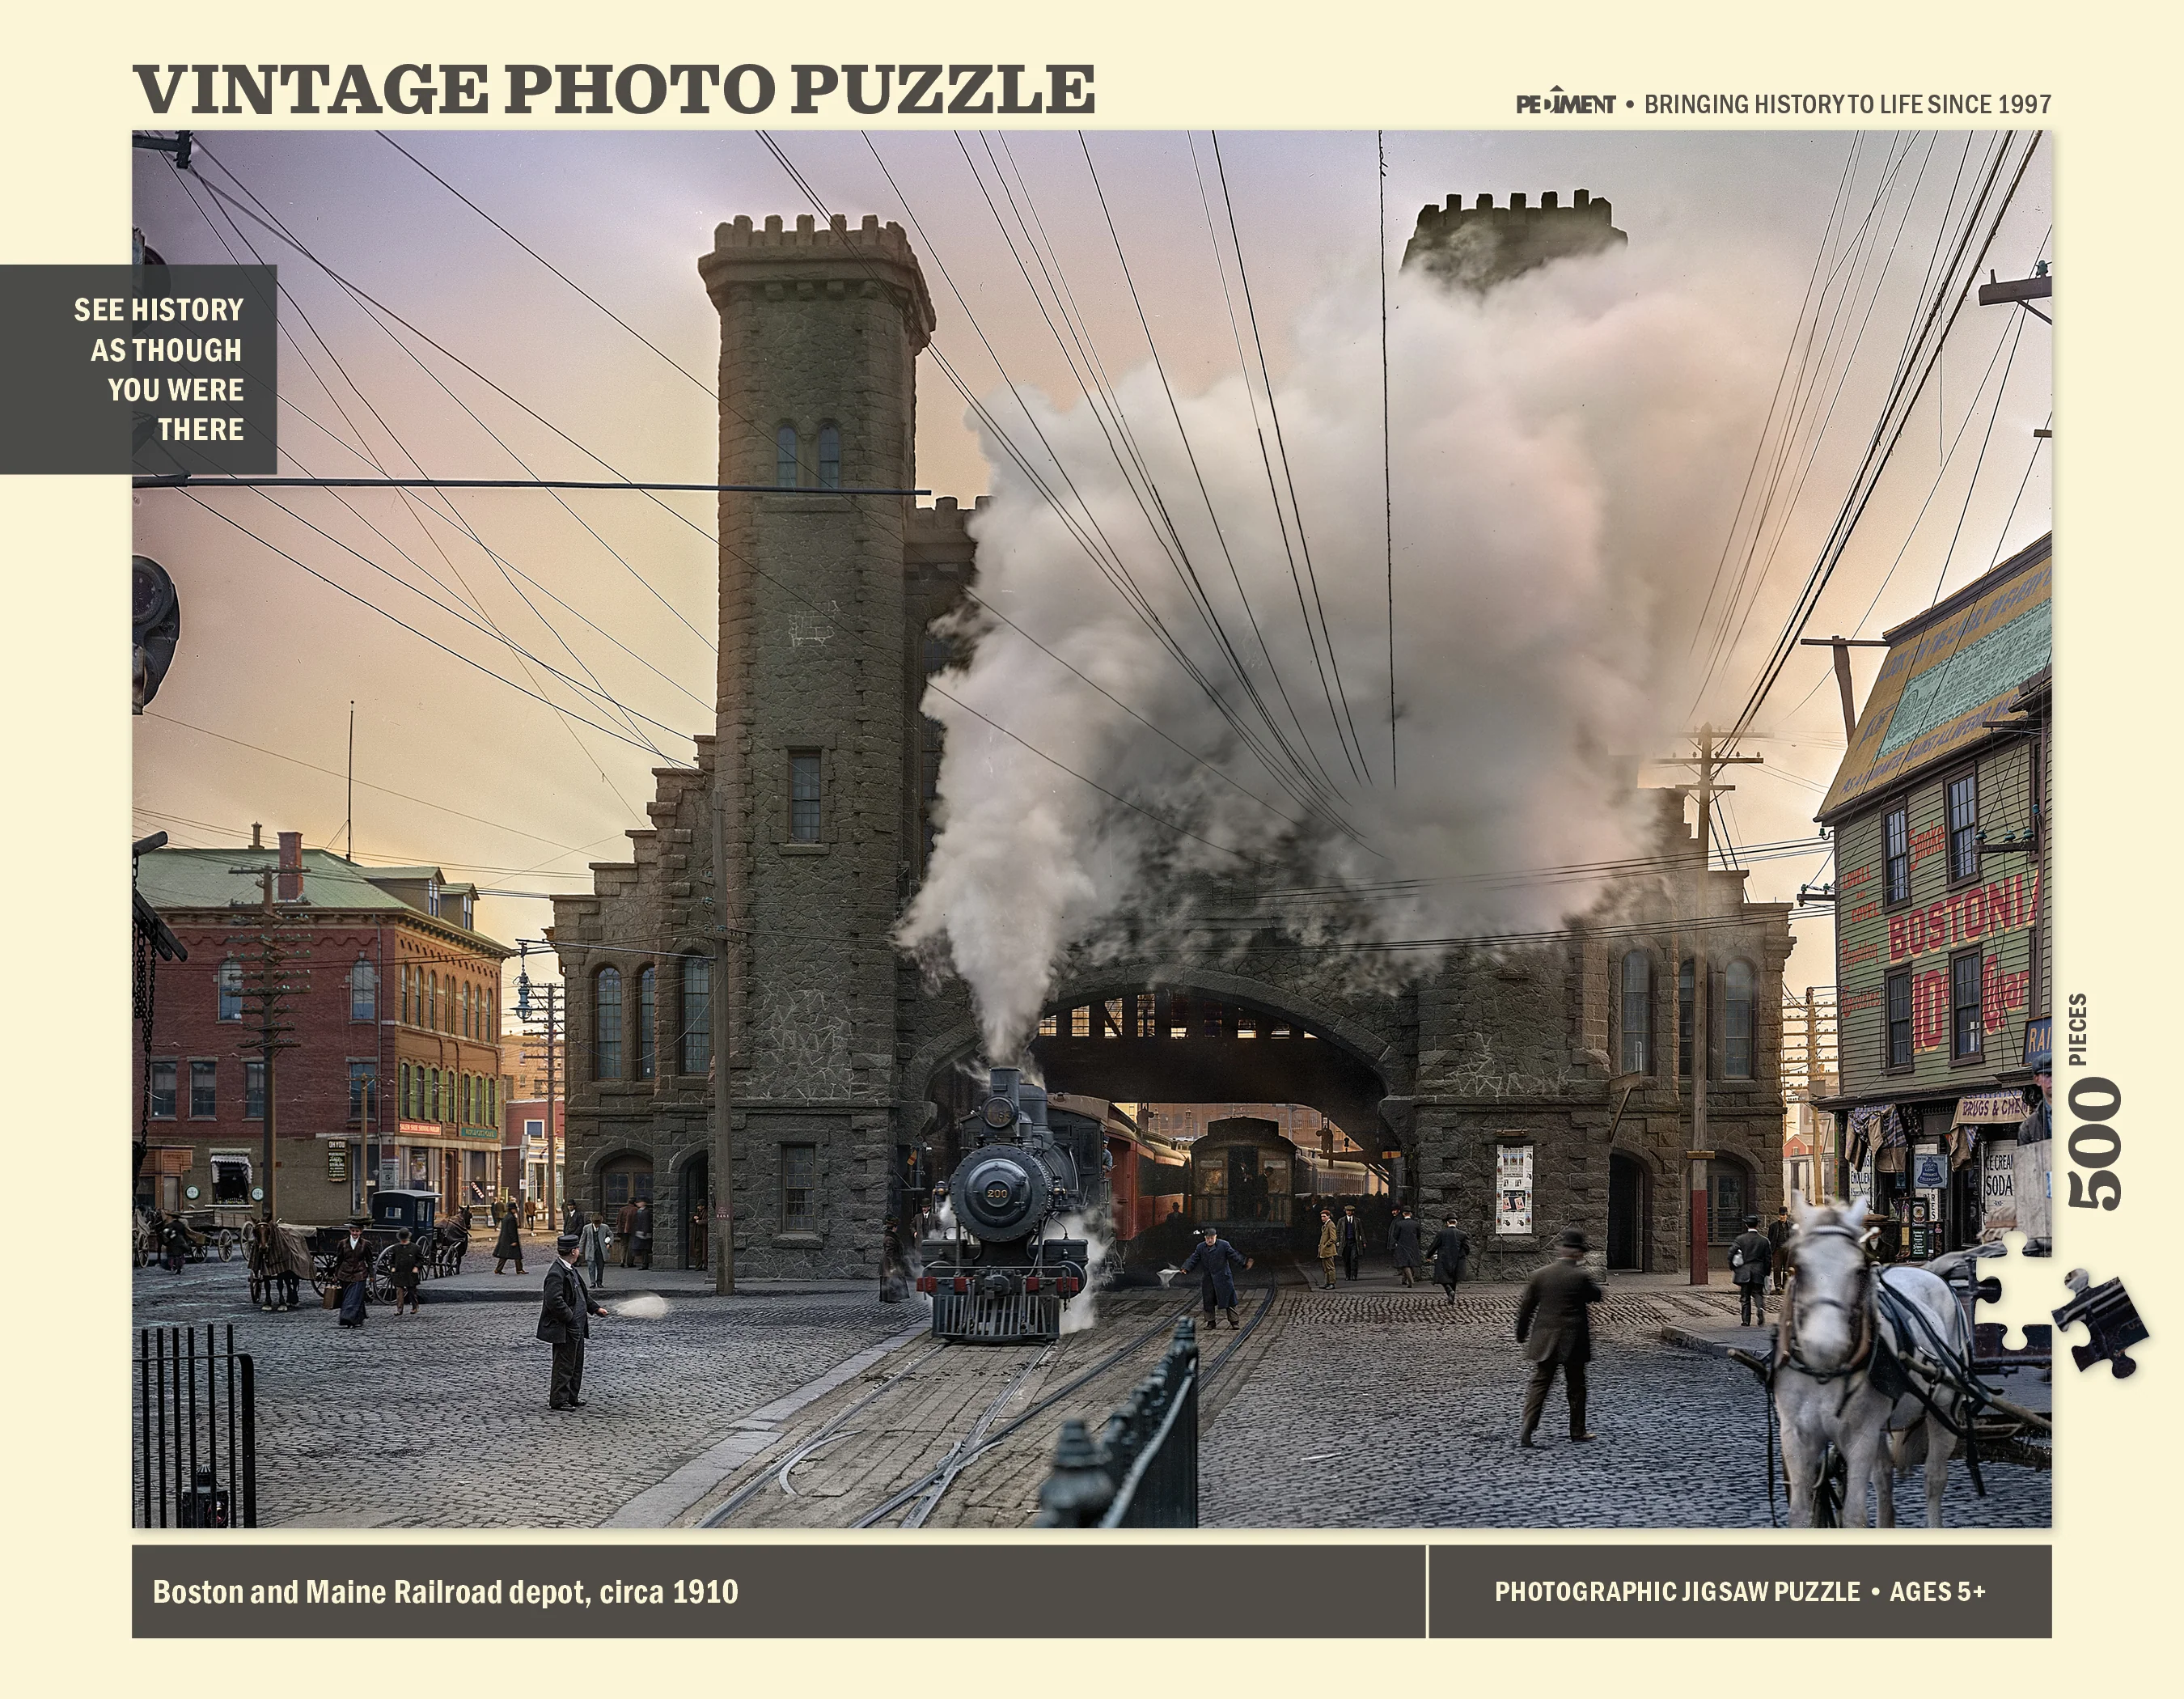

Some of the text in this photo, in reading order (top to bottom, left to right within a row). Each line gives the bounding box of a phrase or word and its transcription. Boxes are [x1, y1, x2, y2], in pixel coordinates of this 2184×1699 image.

[1909, 820, 1945, 871] Smoke
[1842, 865, 1872, 889] LOVELL
[1852, 901, 1880, 922] COVEL
[1983, 954, 2029, 1035] Cigar
[2029, 1027, 2052, 1053] RAI
[1962, 1097, 2028, 1116] DRUGS & CHEM
[1985, 1155, 1993, 1171] CE
[987, 1189, 1008, 1198] 200
[1986, 1175, 2013, 1197] SODA
